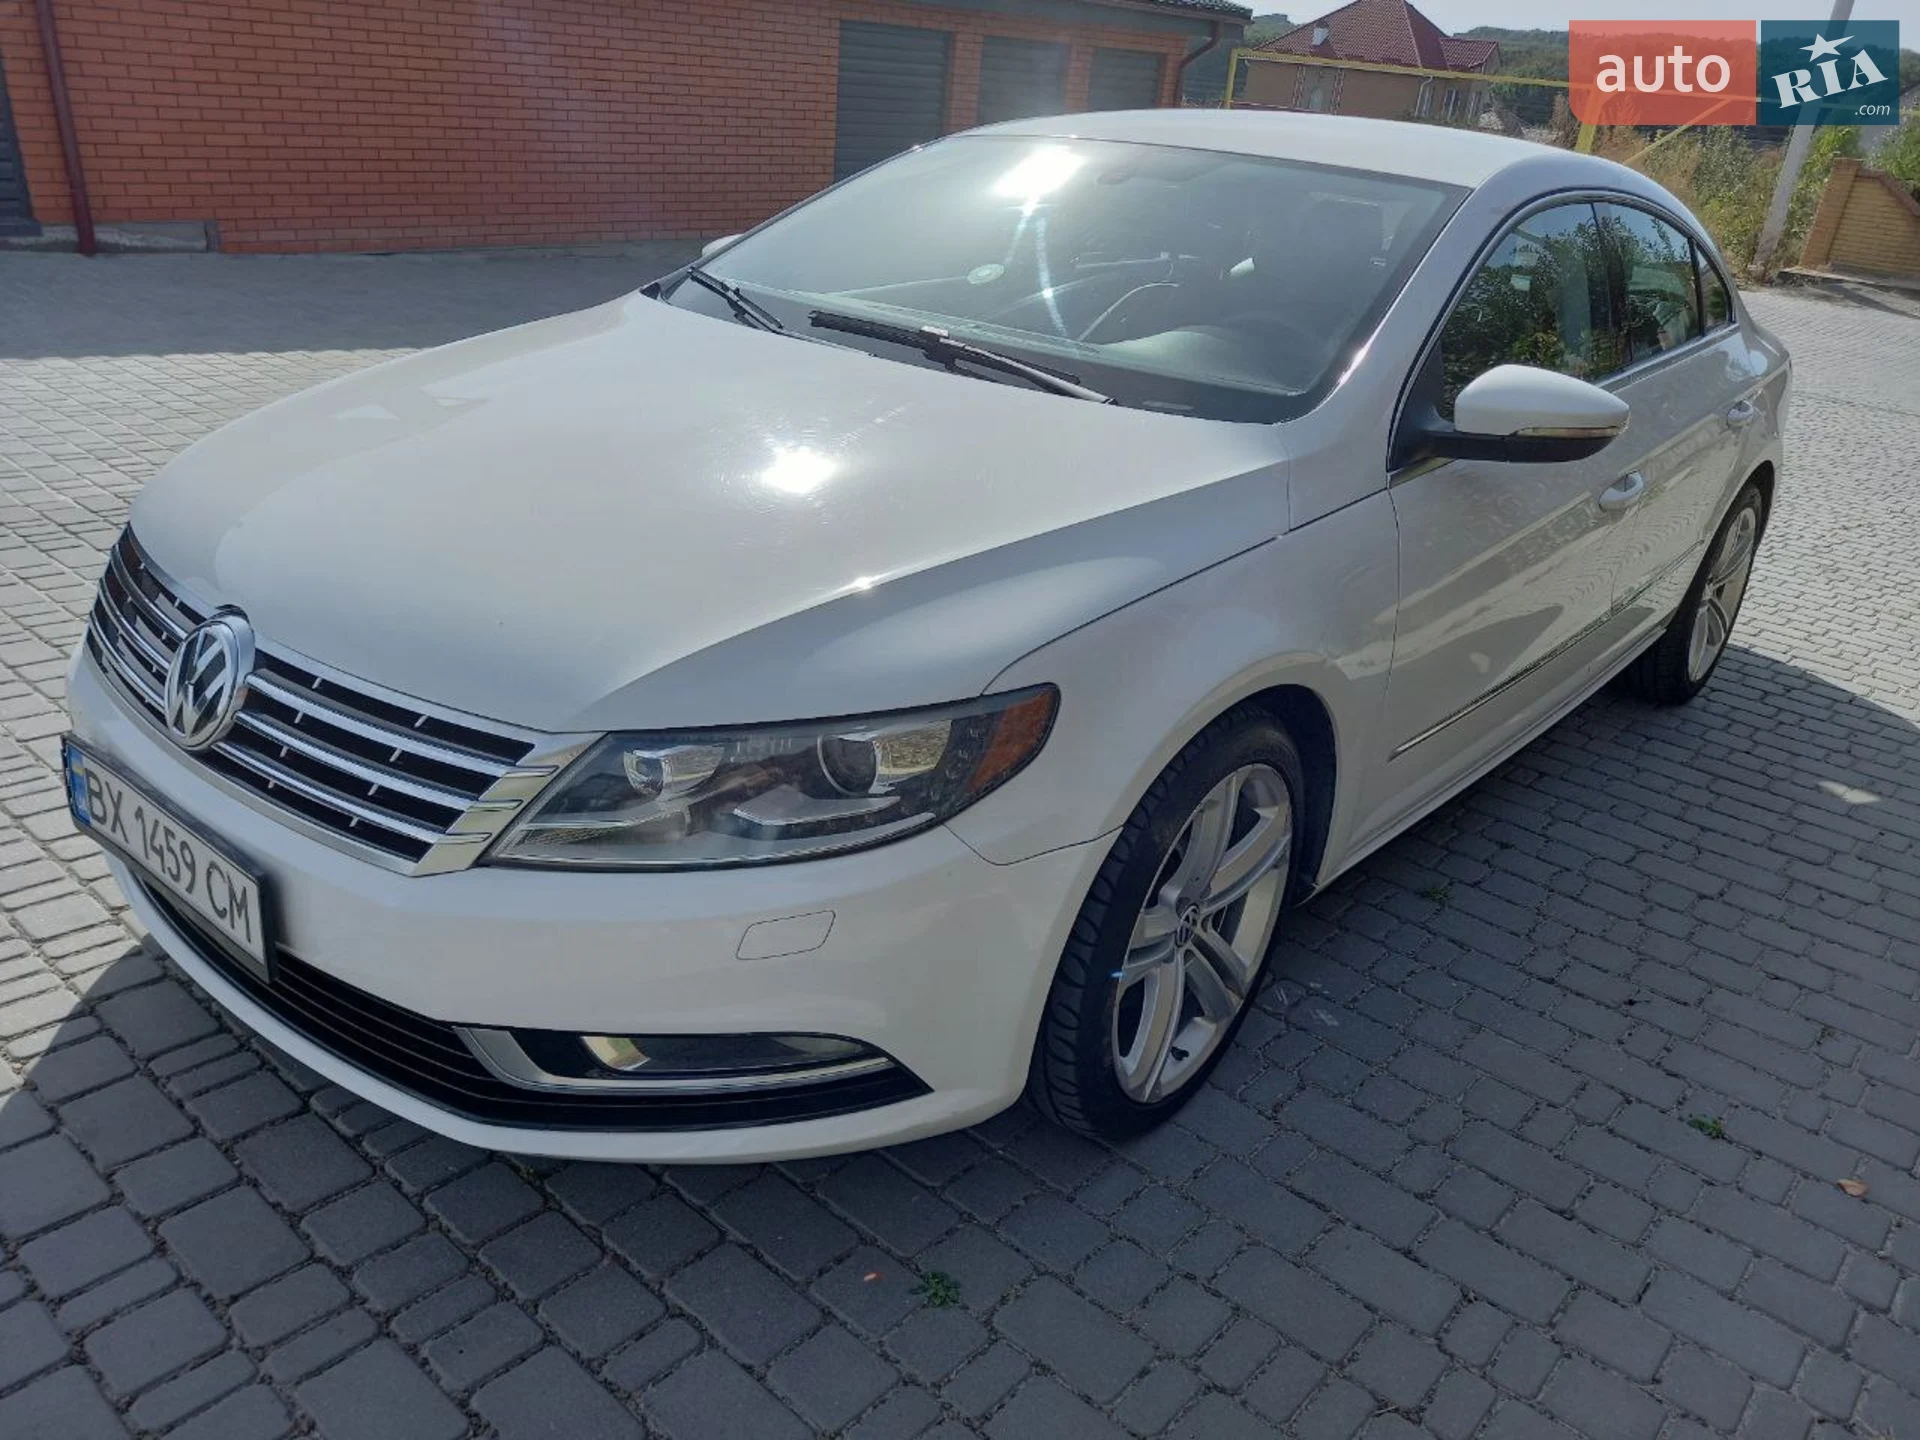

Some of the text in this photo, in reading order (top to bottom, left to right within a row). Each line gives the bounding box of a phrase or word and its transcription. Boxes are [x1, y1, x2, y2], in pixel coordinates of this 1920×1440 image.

[84, 767, 251, 943] BX 1459 CM
